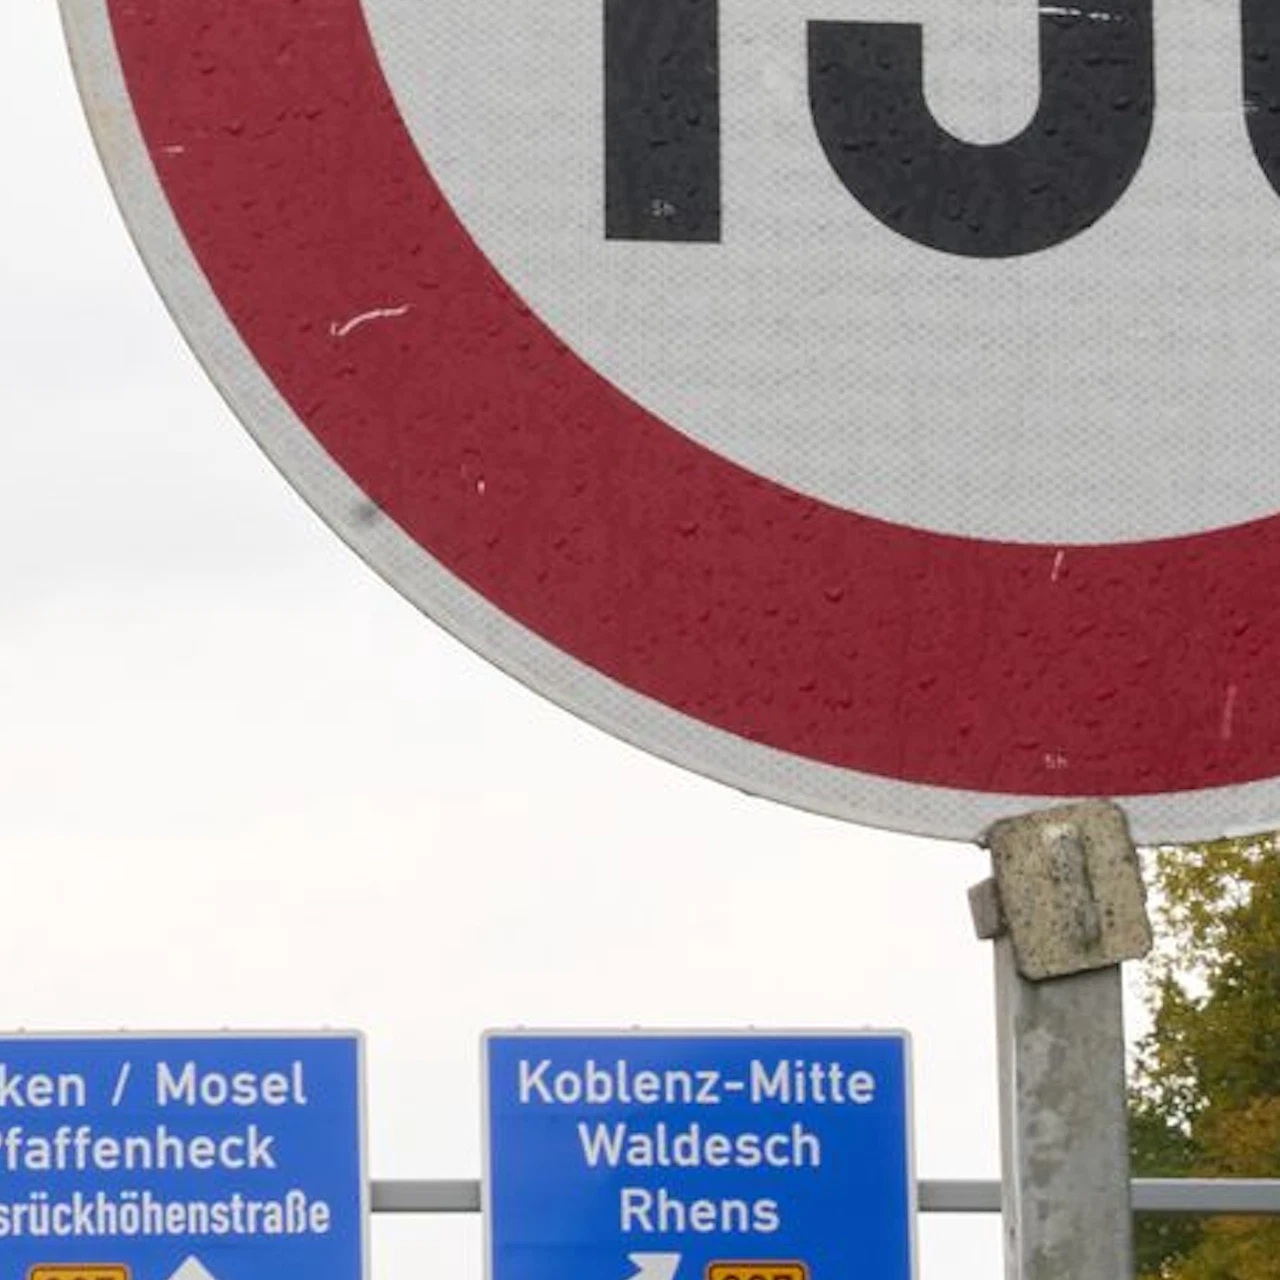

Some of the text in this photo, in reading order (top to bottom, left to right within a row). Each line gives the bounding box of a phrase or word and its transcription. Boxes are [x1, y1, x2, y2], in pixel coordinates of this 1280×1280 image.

[112, 1062, 130, 1106] /
[156, 1061, 307, 1106] Mosel
[518, 1059, 876, 1105] Koblenz-Mitte
[577, 1122, 821, 1167] Waldesch
[619, 1188, 779, 1233] Rhens
